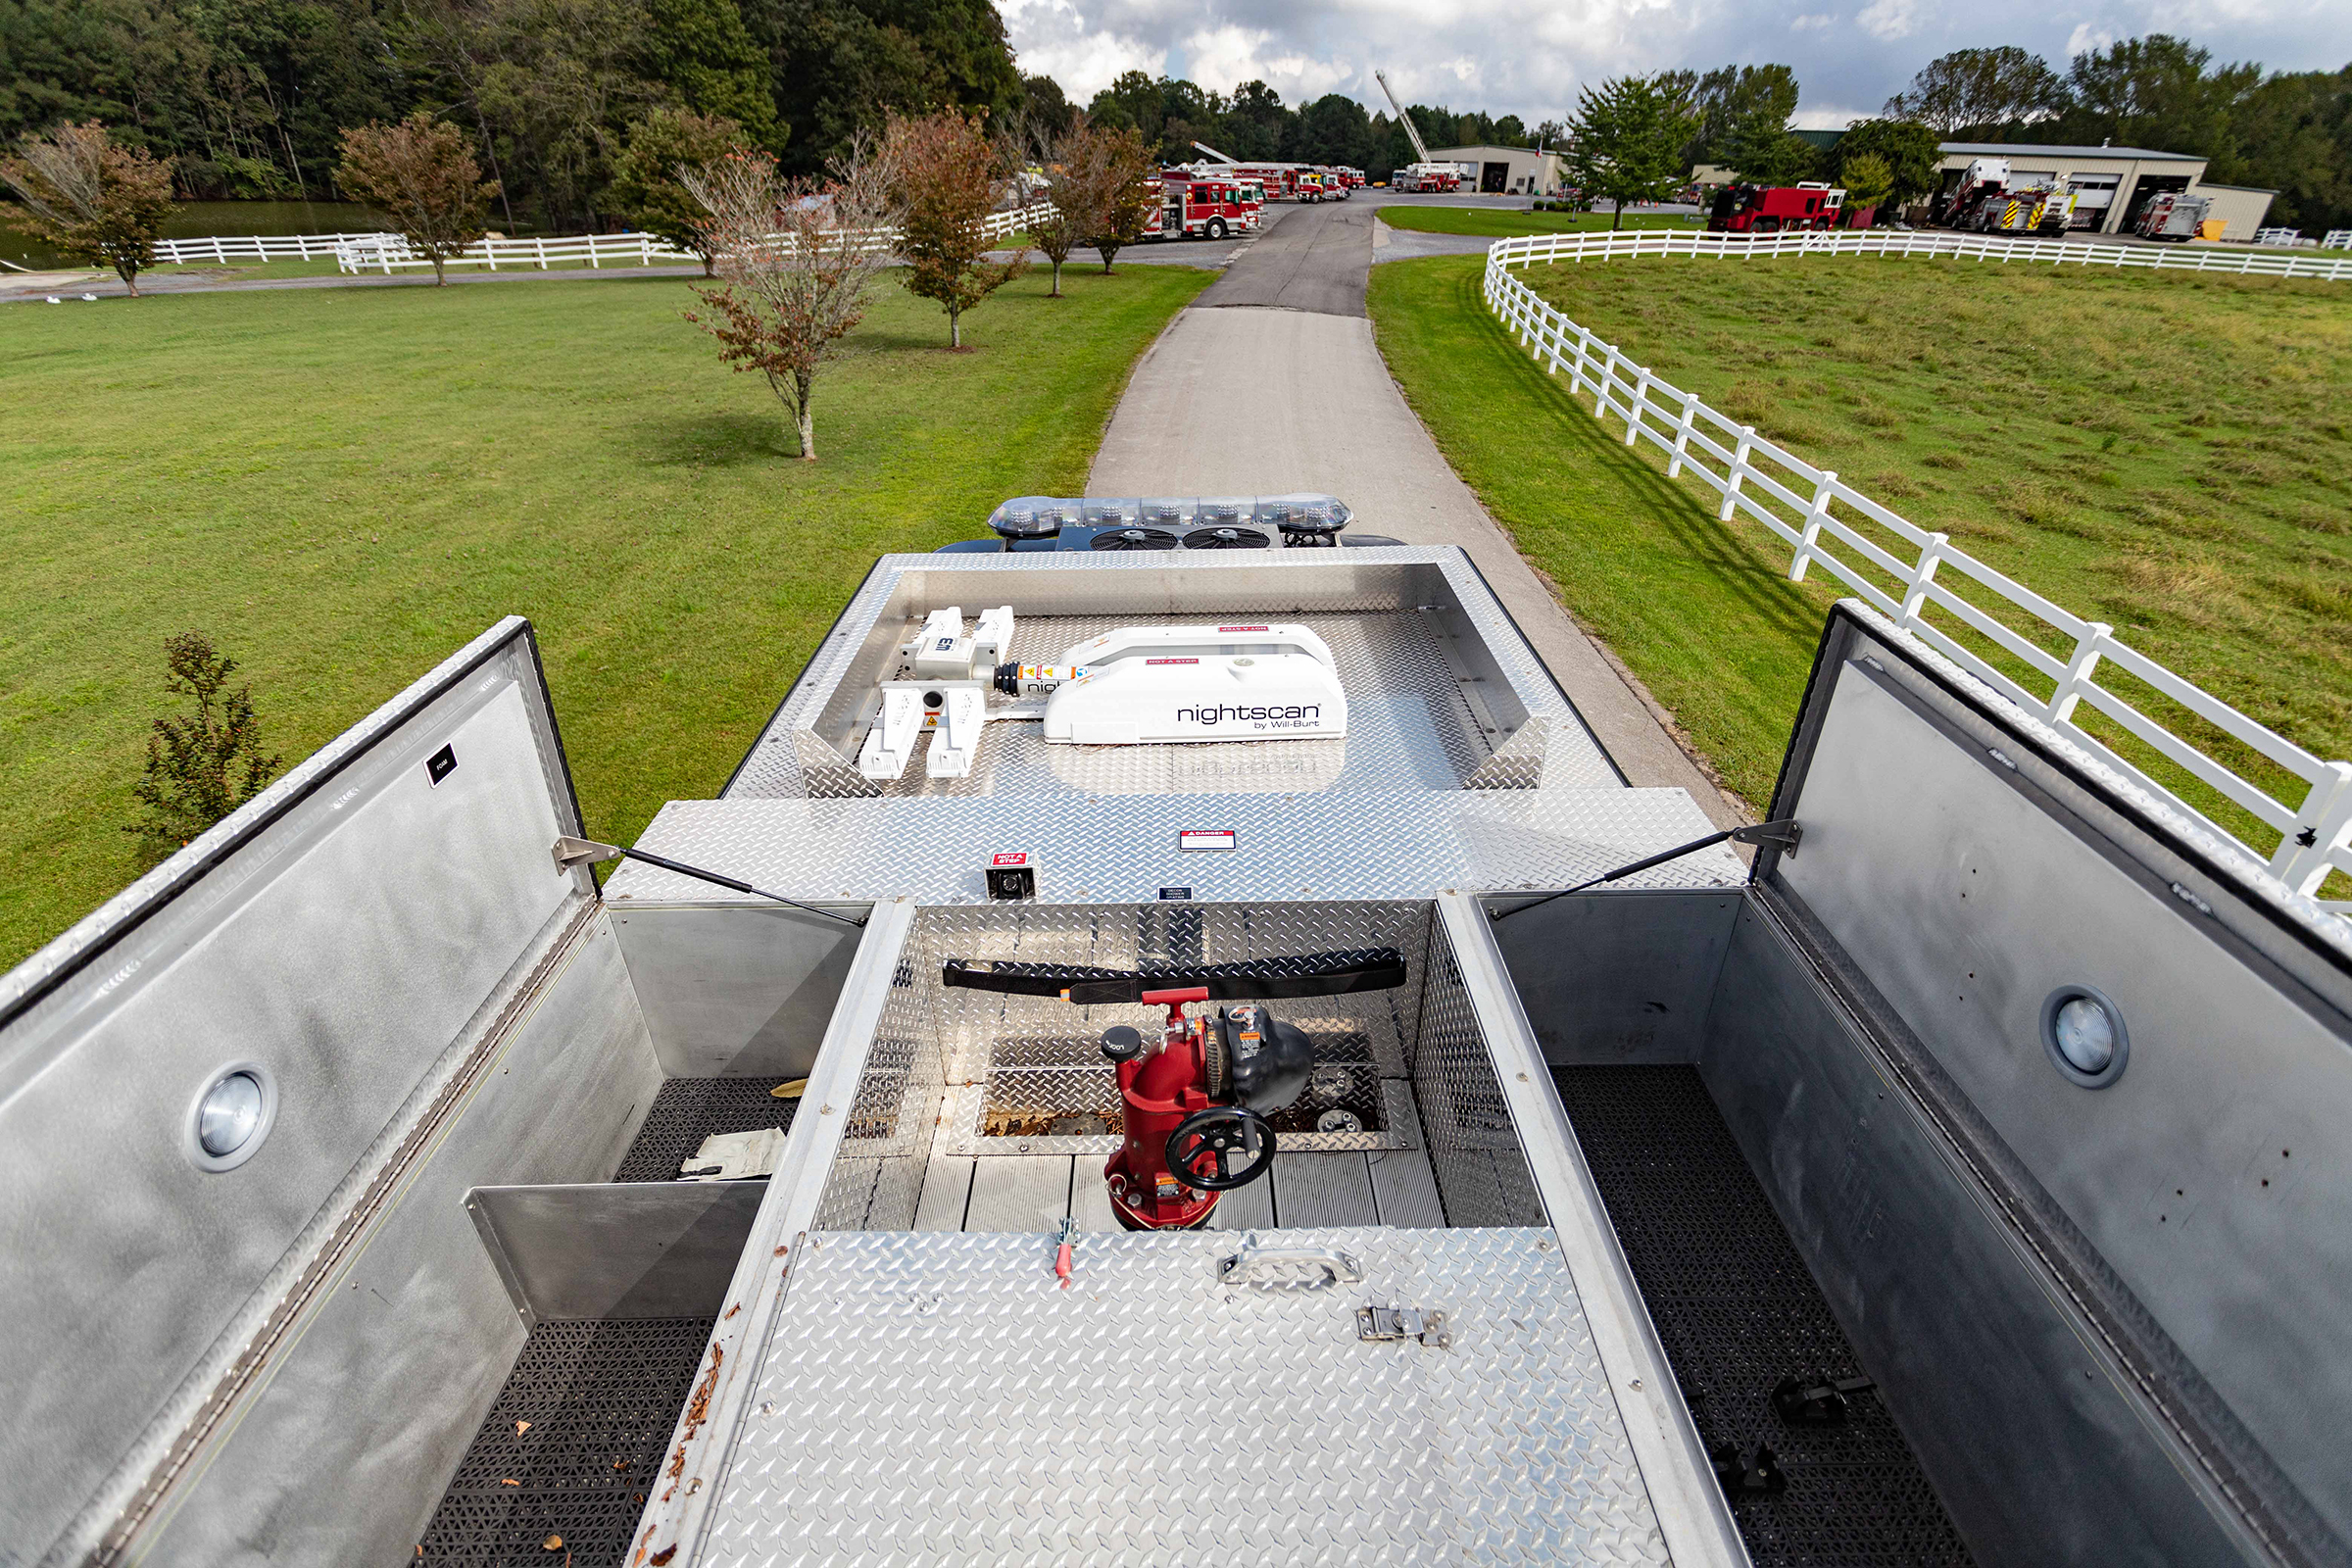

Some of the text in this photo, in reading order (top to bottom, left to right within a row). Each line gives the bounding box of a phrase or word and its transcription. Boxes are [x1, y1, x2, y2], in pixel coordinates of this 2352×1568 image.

[1177, 704, 1319, 725] nightscan
[1253, 720, 1320, 730] by Will-Burt
[436, 759, 448, 771] FOAM
